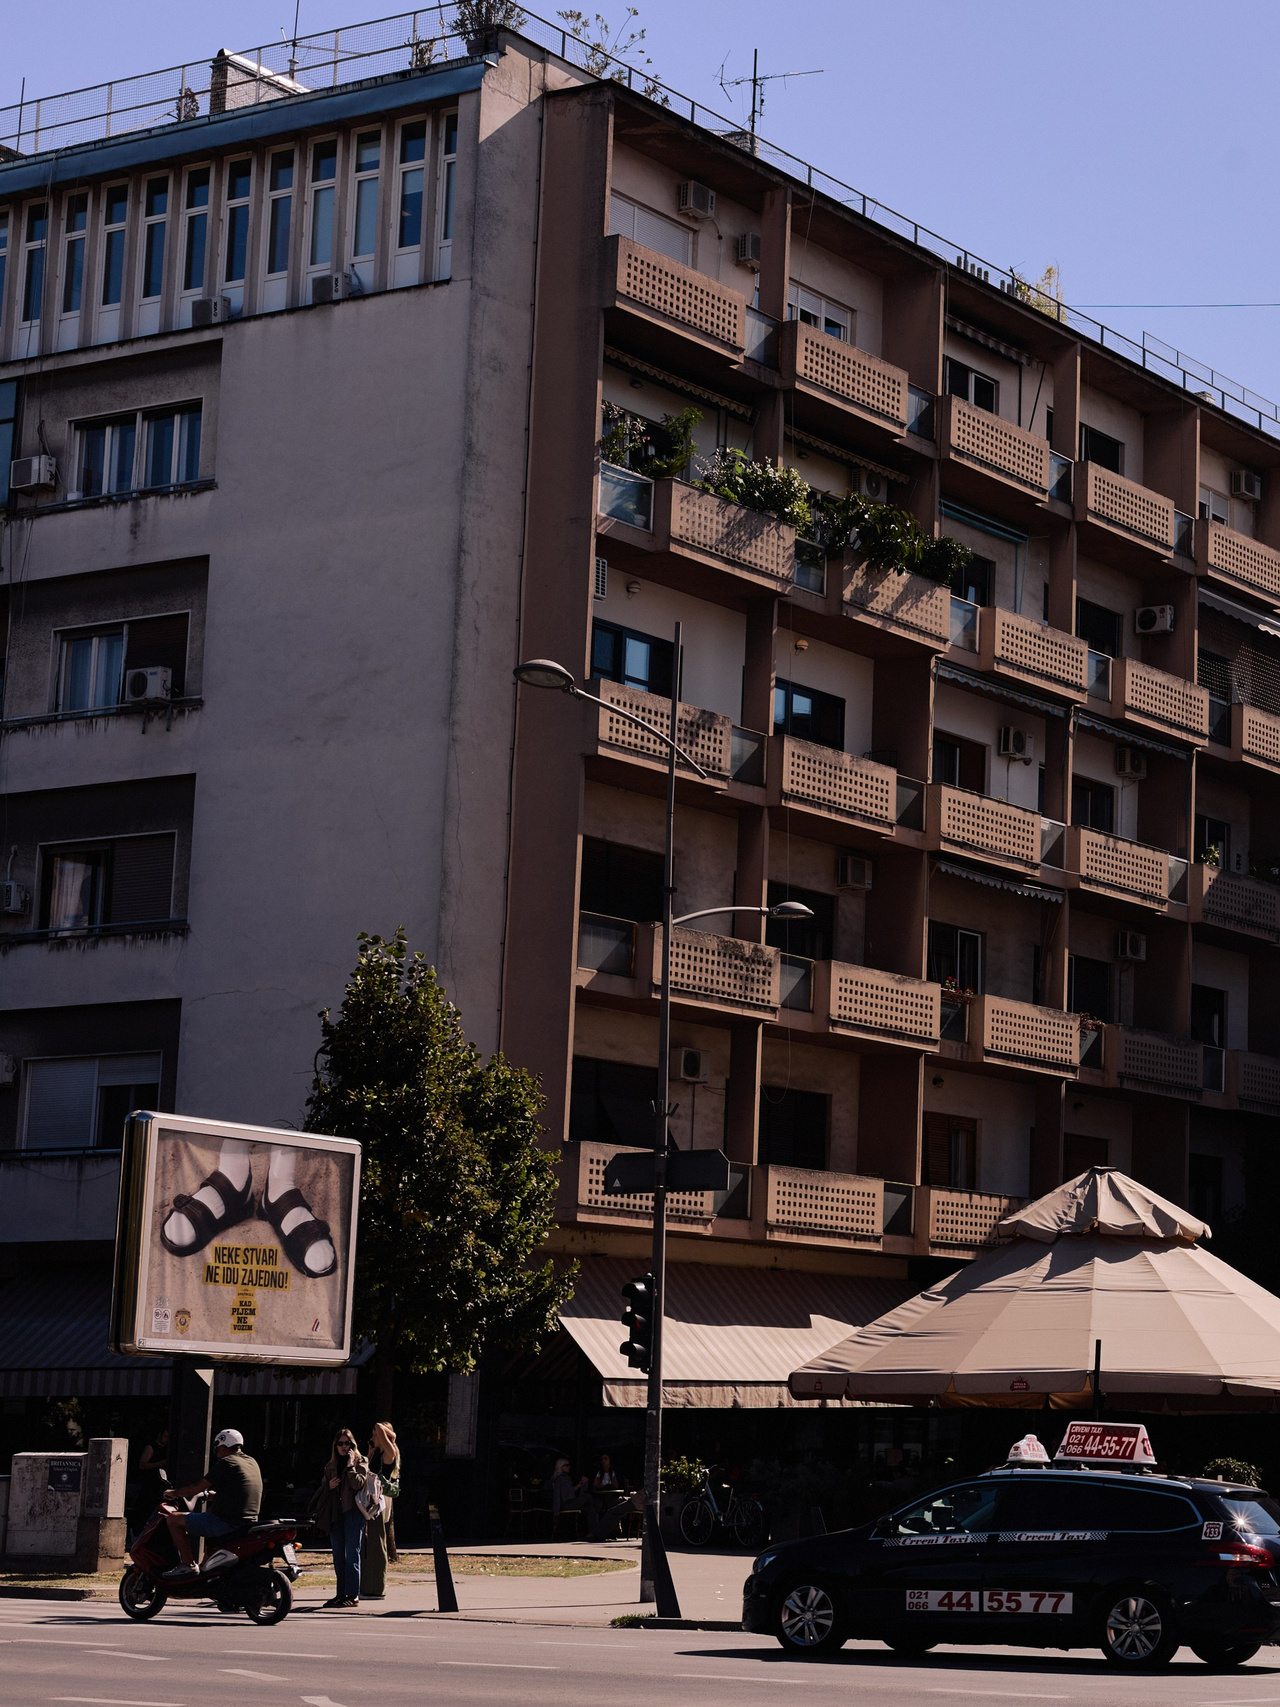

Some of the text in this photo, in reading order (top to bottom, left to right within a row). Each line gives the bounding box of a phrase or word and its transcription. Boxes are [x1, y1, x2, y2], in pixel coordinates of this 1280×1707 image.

[214, 1246, 278, 1266] NEKE STVARI
[205, 1265, 288, 1289] NE IDU ZAJEDNO!
[231, 1307, 256, 1316] PIJEM
[237, 1316, 248, 1324] NE
[1066, 1445, 1083, 1454] 066
[1069, 1435, 1136, 1456] 021 44-55-77
[1017, 1532, 1088, 1541] Crveni Taxi
[1206, 1528, 1219, 1537] 133
[901, 1535, 971, 1546] Crveni Taxi
[908, 1601, 929, 1610] 066
[909, 1591, 1065, 1612] 021 44 55 77
